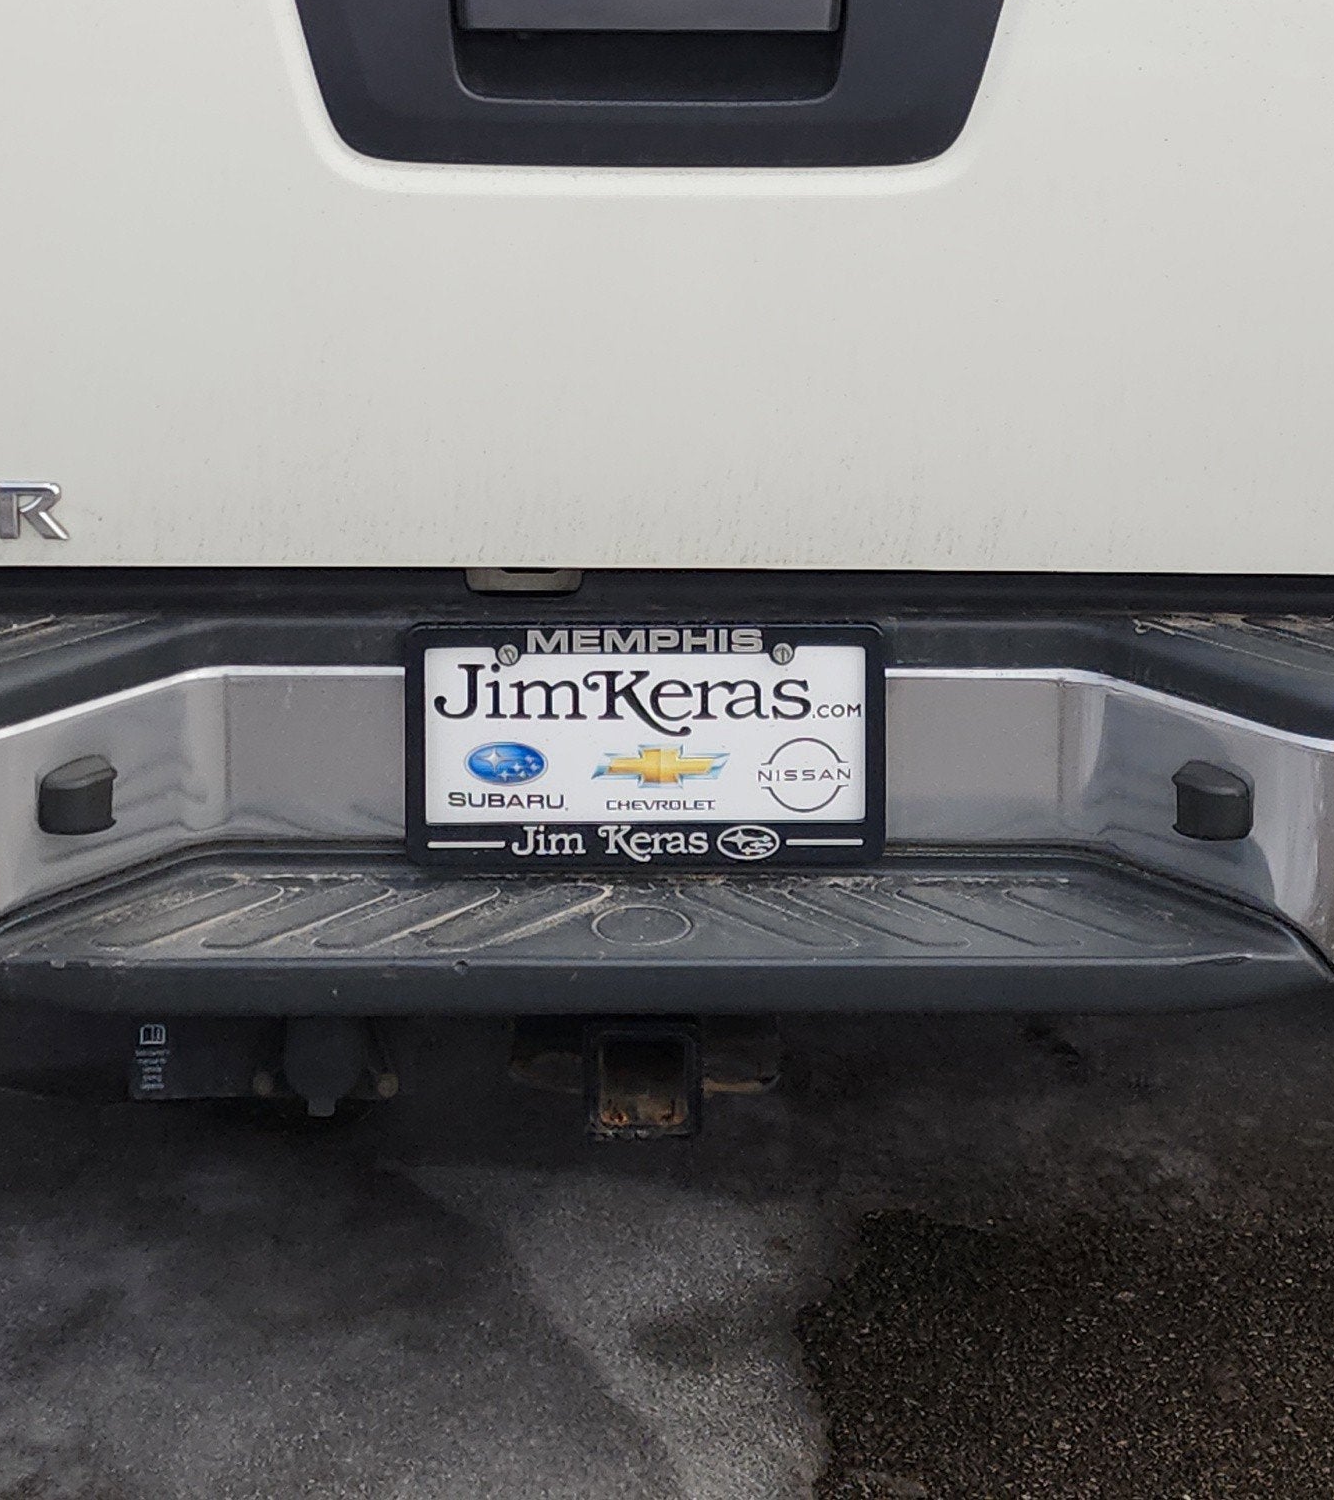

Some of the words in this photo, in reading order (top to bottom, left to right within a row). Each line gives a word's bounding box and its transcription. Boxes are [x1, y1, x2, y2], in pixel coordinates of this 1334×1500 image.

[525, 629, 764, 654] MEMPHIS
[757, 768, 852, 783] NISSAN
[447, 791, 567, 810] SUBARU
[605, 799, 717, 812] CHEVROLET
[510, 826, 586, 856] Jim
[597, 826, 710, 862] Keras
